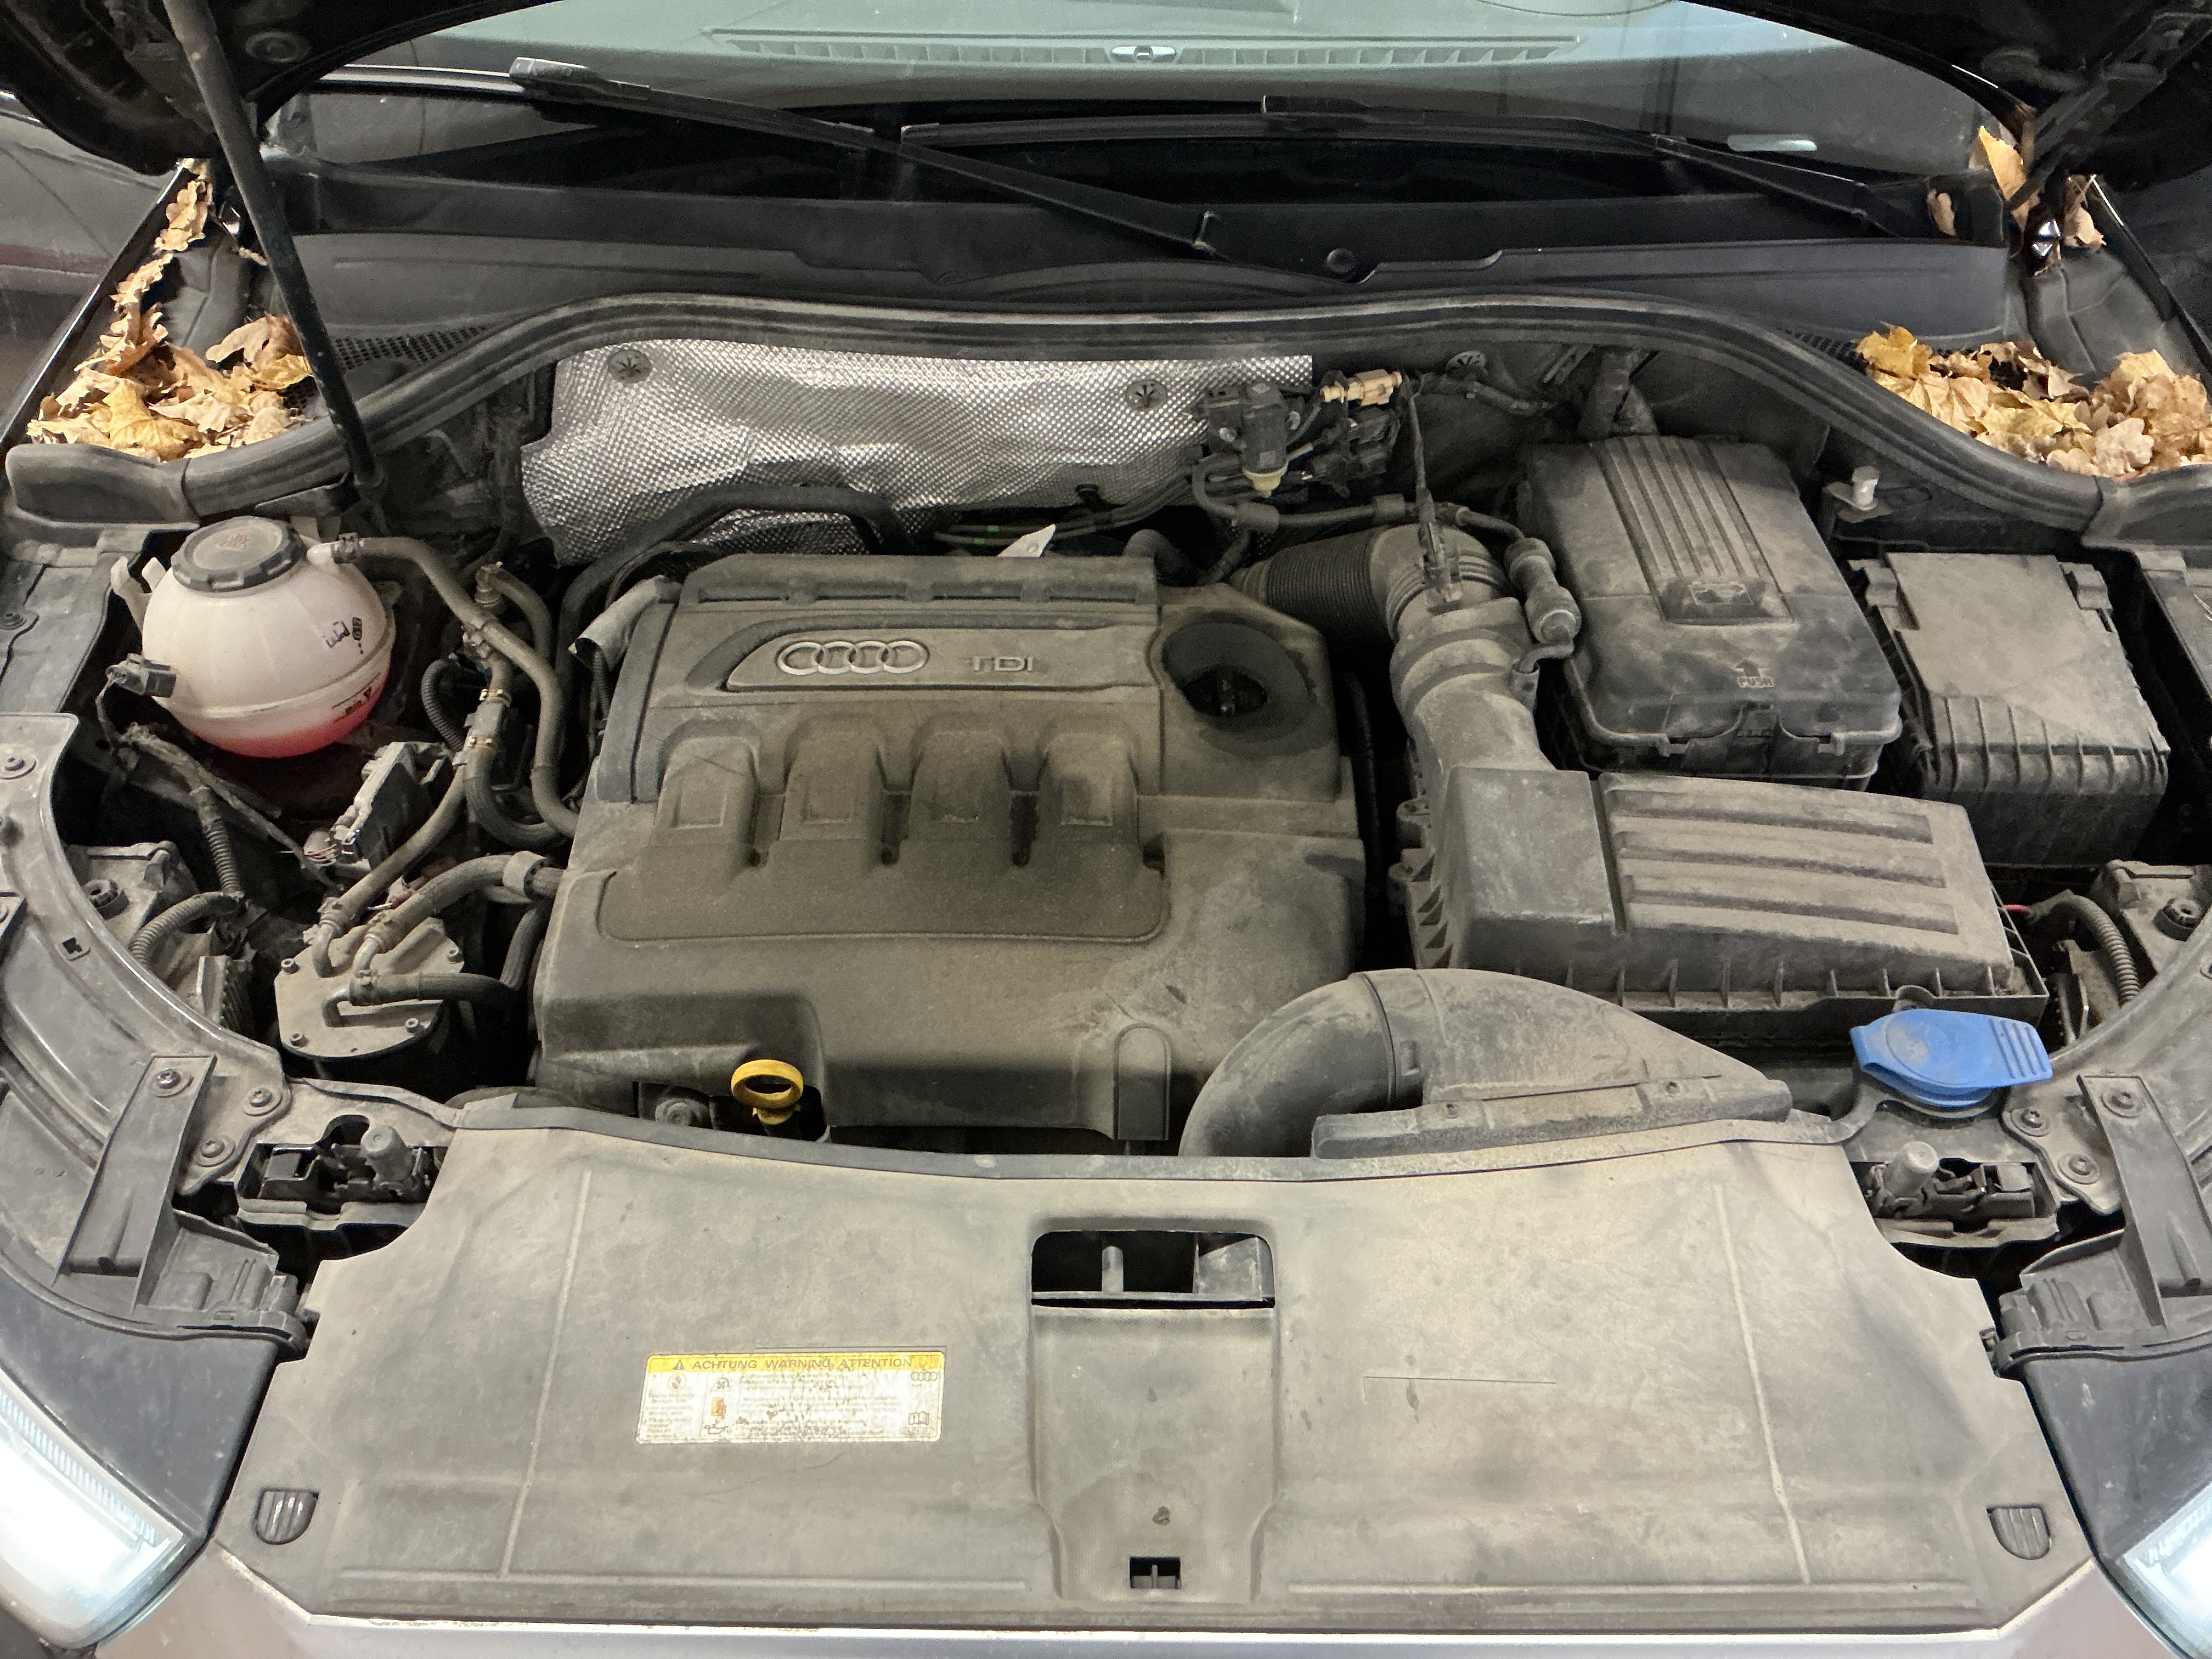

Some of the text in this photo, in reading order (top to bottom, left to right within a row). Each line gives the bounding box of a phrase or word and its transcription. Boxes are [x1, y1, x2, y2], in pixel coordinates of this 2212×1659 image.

[964, 657, 1033, 671] TDI
[1738, 677, 1773, 687] PUSH
[692, 1358, 912, 1369] ACHTUNG WARNING ATTENTION
